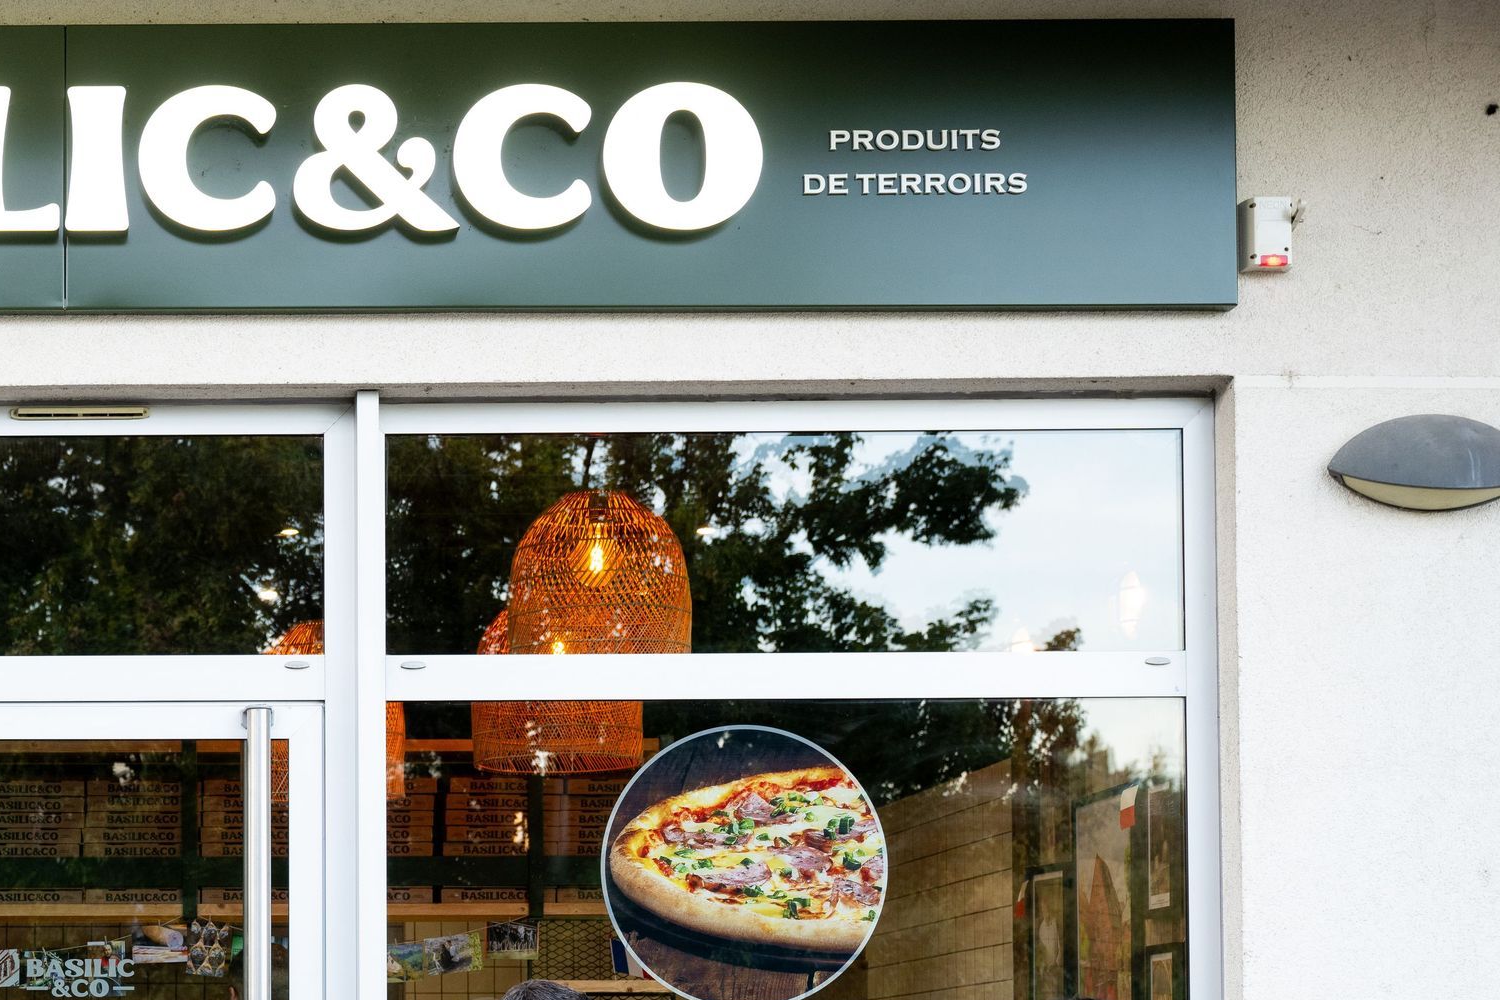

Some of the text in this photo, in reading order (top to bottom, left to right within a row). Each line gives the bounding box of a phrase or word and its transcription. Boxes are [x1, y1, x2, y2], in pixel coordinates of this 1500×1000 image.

[830, 129, 1001, 151] PRODUITS
[803, 173, 1028, 196] DE TERROIRS
[107, 815, 179, 824] BASILIC&CO
[102, 832, 175, 841] BASILIC&CO
[104, 848, 177, 856] BASILIC&CO
[105, 893, 178, 902] BASILIC&CO
[26, 958, 135, 978] BASILIC
[51, 979, 110, 998] &CO
